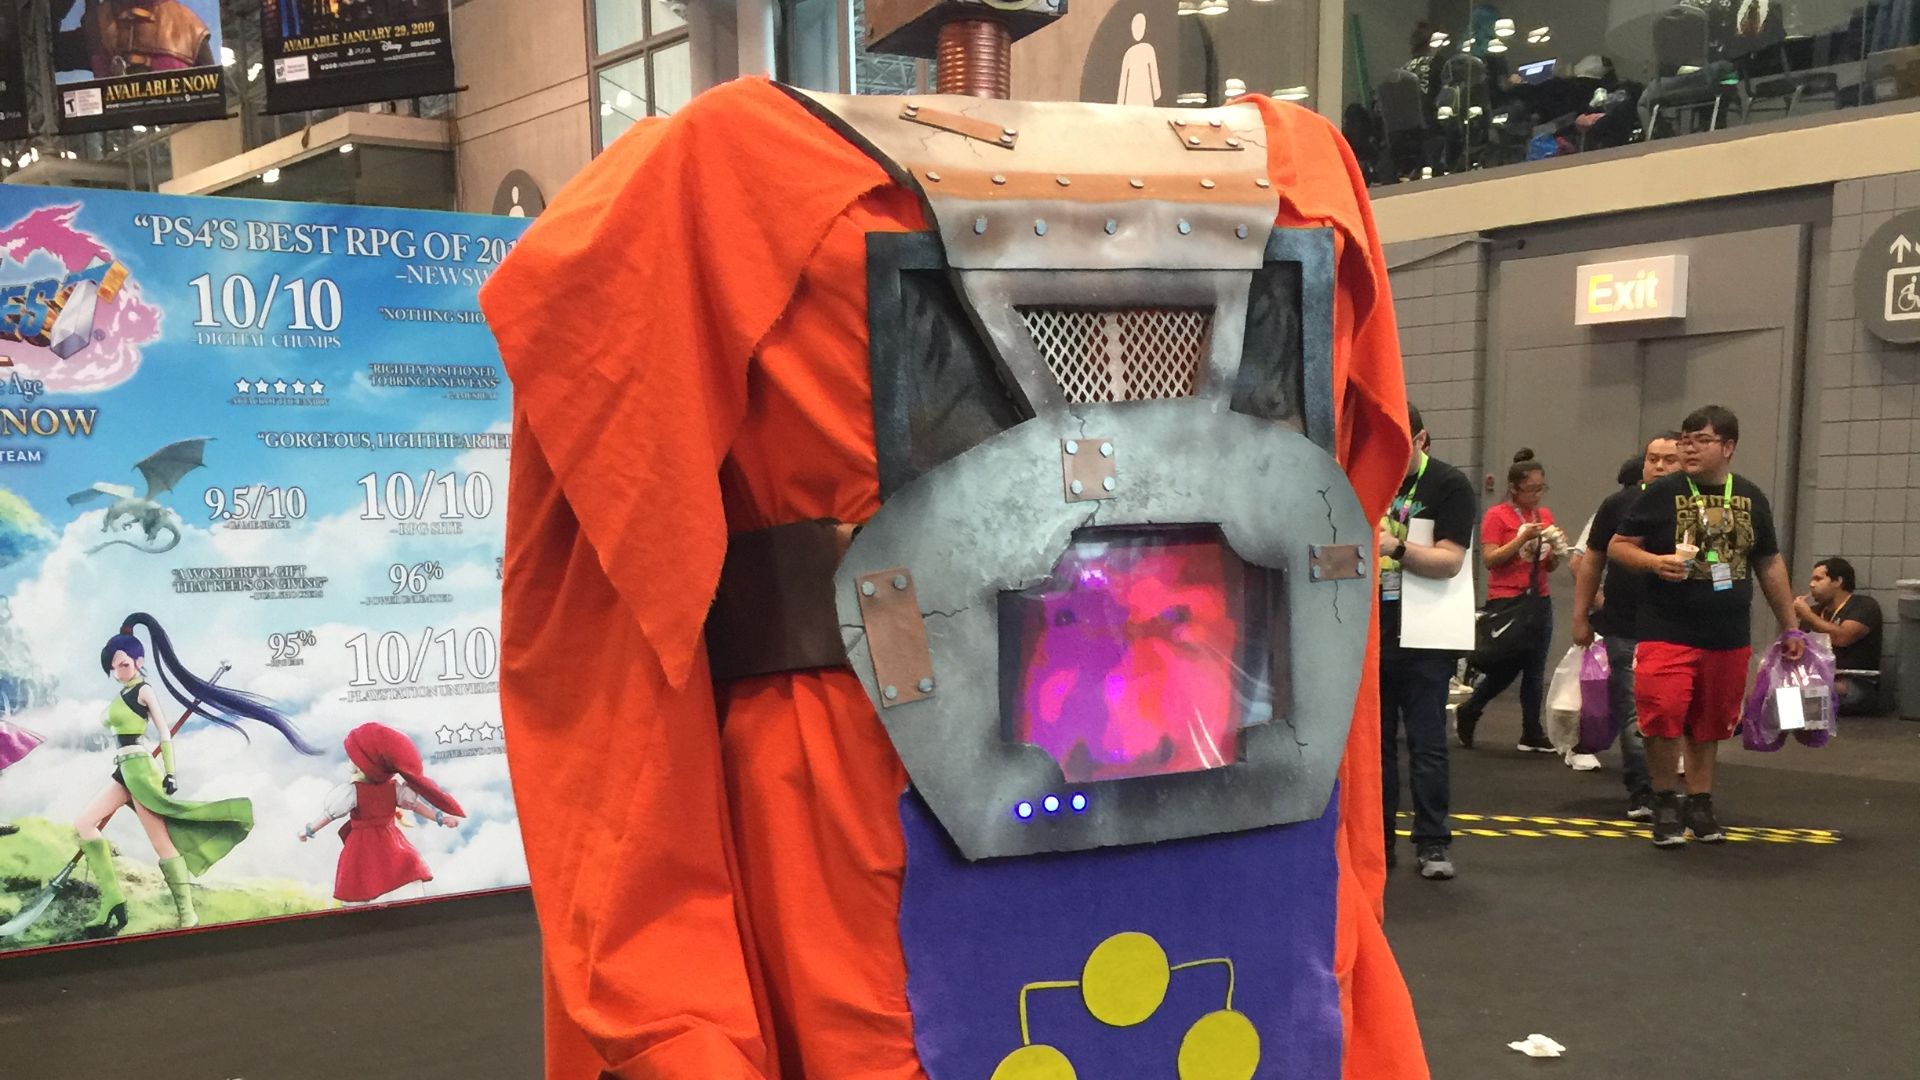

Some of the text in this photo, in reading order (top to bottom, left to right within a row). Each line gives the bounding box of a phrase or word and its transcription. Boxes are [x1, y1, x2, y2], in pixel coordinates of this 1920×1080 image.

[282, 21, 435, 53] AVAILABLE JANUARY 29, 2019
[105, 78, 181, 101] AVAILABLE
[182, 73, 219, 93] NOW
[133, 214, 239, 250] "PS4'S
[246, 220, 338, 255] BEST
[344, 226, 417, 260] RPG
[423, 231, 472, 262] OF
[188, 272, 343, 332] 10/10
[1588, 270, 1659, 314] Exit
[271, 333, 342, 349] CHUMPS
[8, 371, 44, 403] Age
[0, 407, 97, 438] NOW
[0, 450, 41, 462] TEAM
[257, 431, 375, 451] "GORGEOUS,
[204, 485, 307, 520] 9.5/10
[357, 469, 493, 520] 10/10
[253, 578, 276, 591] ON
[274, 564, 307, 578] GIFT
[388, 560, 444, 595] 96%
[267, 630, 317, 660] 95%
[344, 626, 497, 687] 10/10
